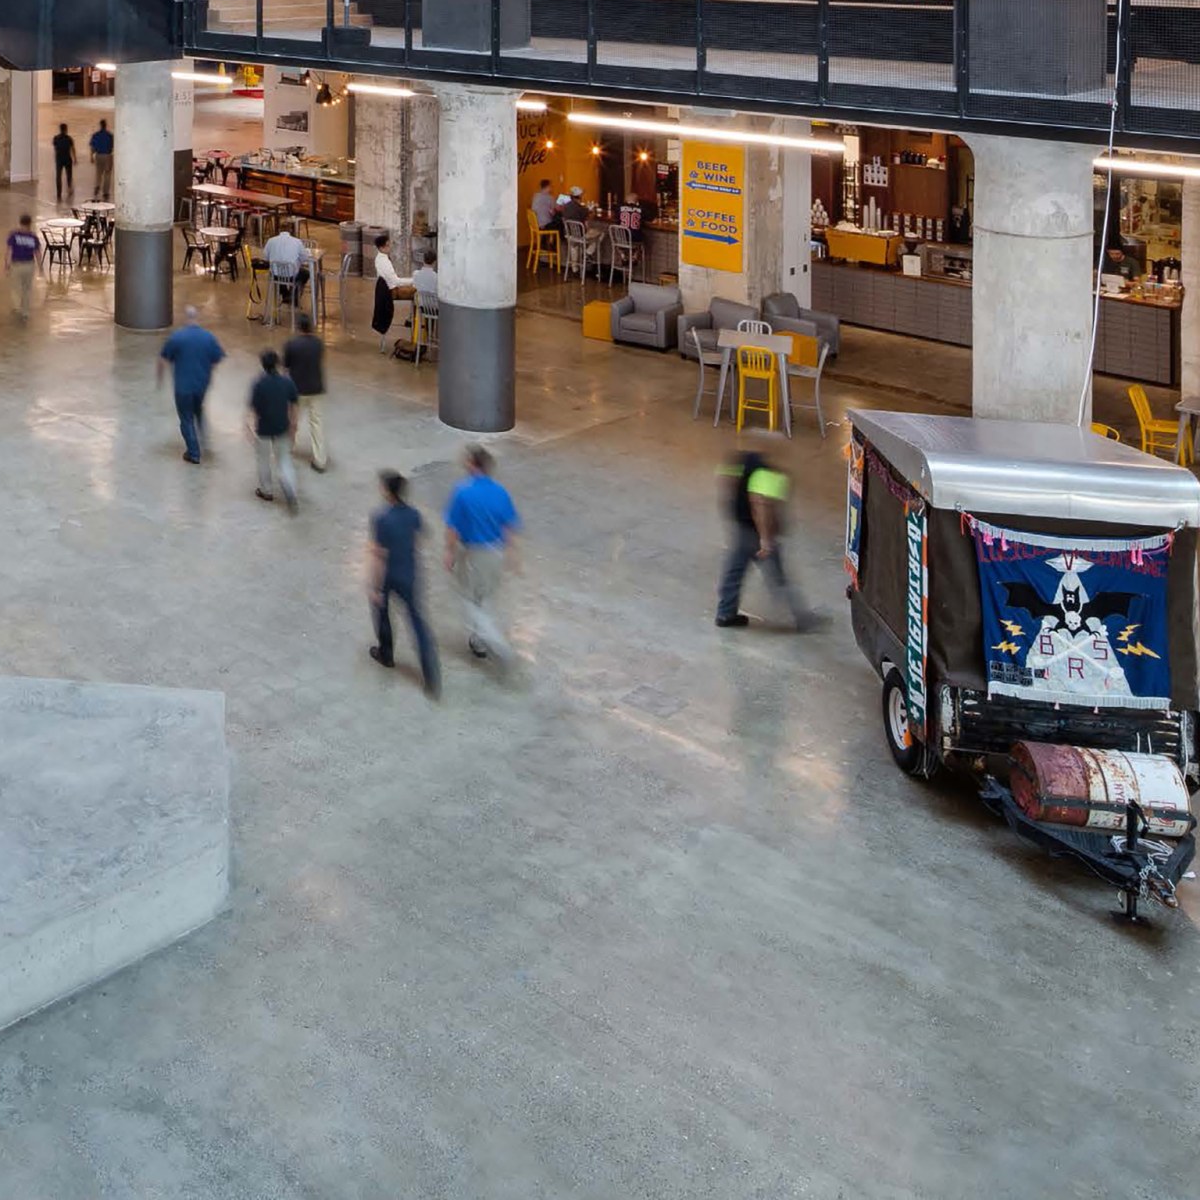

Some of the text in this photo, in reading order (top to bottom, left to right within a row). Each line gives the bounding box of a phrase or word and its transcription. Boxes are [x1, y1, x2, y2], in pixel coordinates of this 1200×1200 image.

[517, 122, 546, 140] UCK
[697, 160, 729, 173] BEER
[688, 170, 736, 185] & WINE
[688, 208, 736, 223] COFFEE
[686, 219, 738, 235] & FOOD
[1040, 634, 1055, 656] B
[1093, 640, 1109, 661] S
[1068, 657, 1084, 680] R
